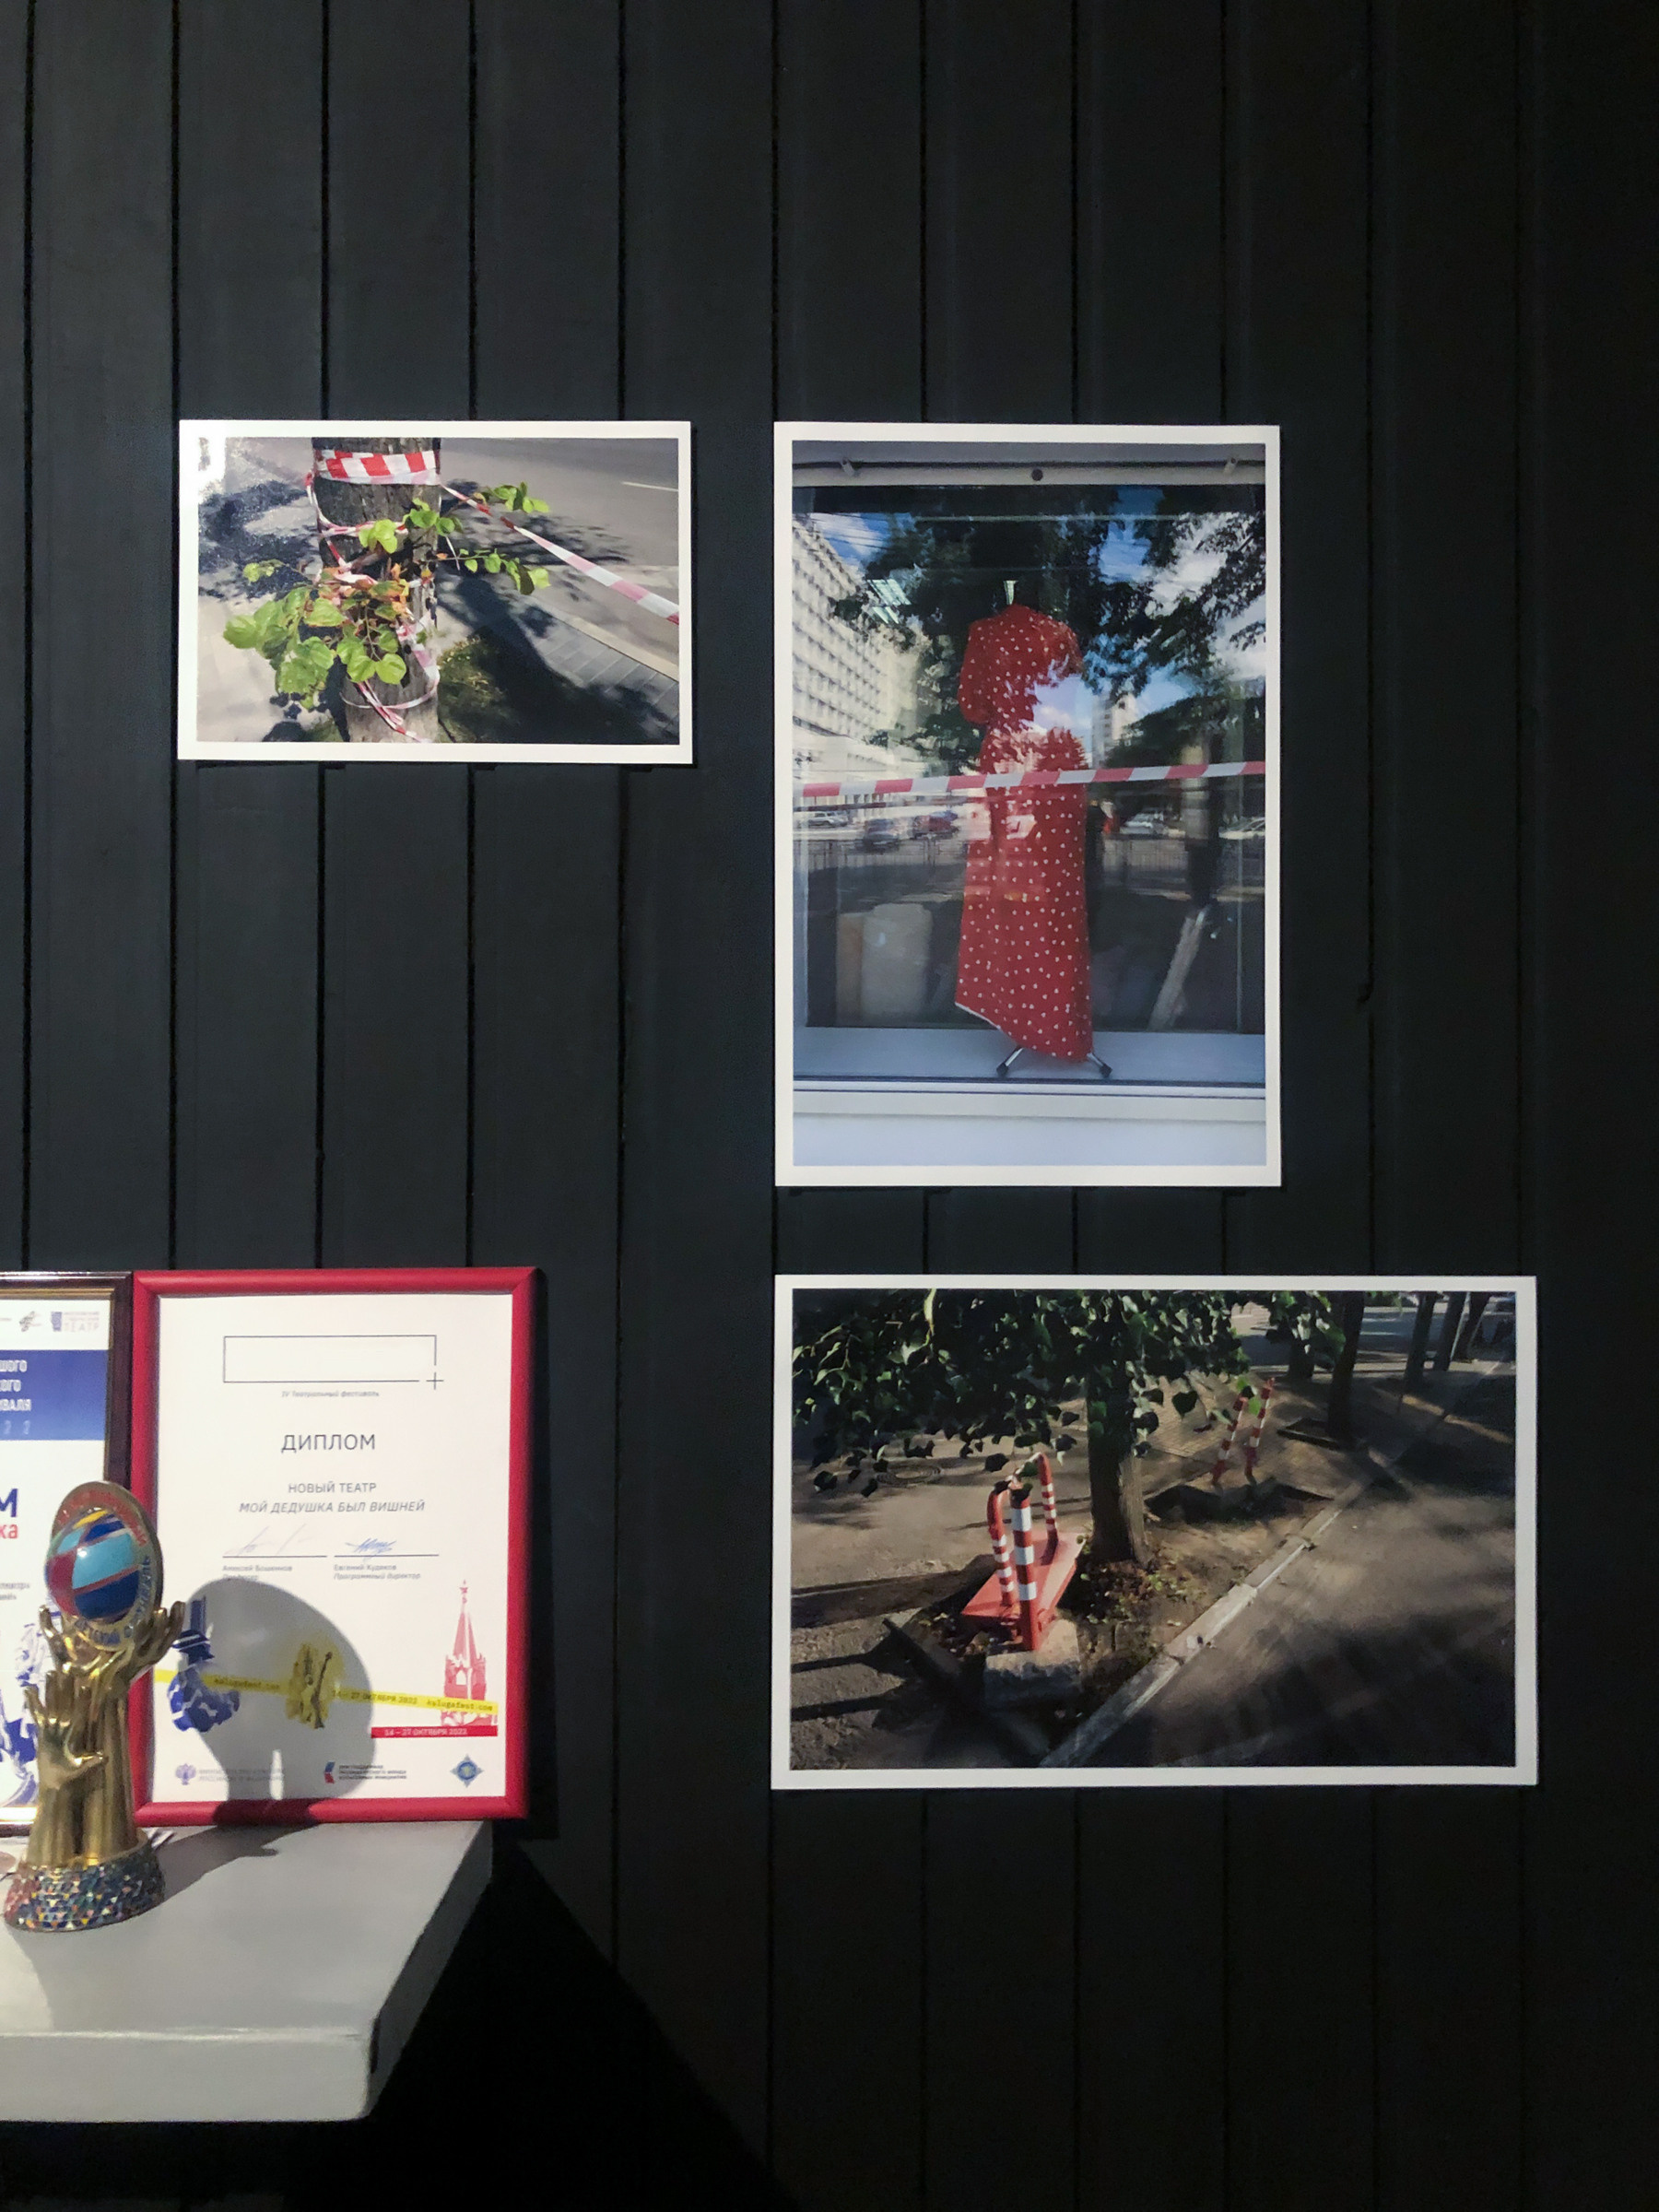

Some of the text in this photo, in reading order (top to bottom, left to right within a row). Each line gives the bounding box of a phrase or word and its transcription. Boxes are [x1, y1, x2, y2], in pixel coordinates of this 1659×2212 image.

[281, 1434, 376, 1453] ДИПЛОМ
[288, 1481, 377, 1493] НОВЫЙ ТЕАТР
[239, 1500, 426, 1513] МОЙ ДЕДУШКА БЫЛ ВИШНЕЙ
